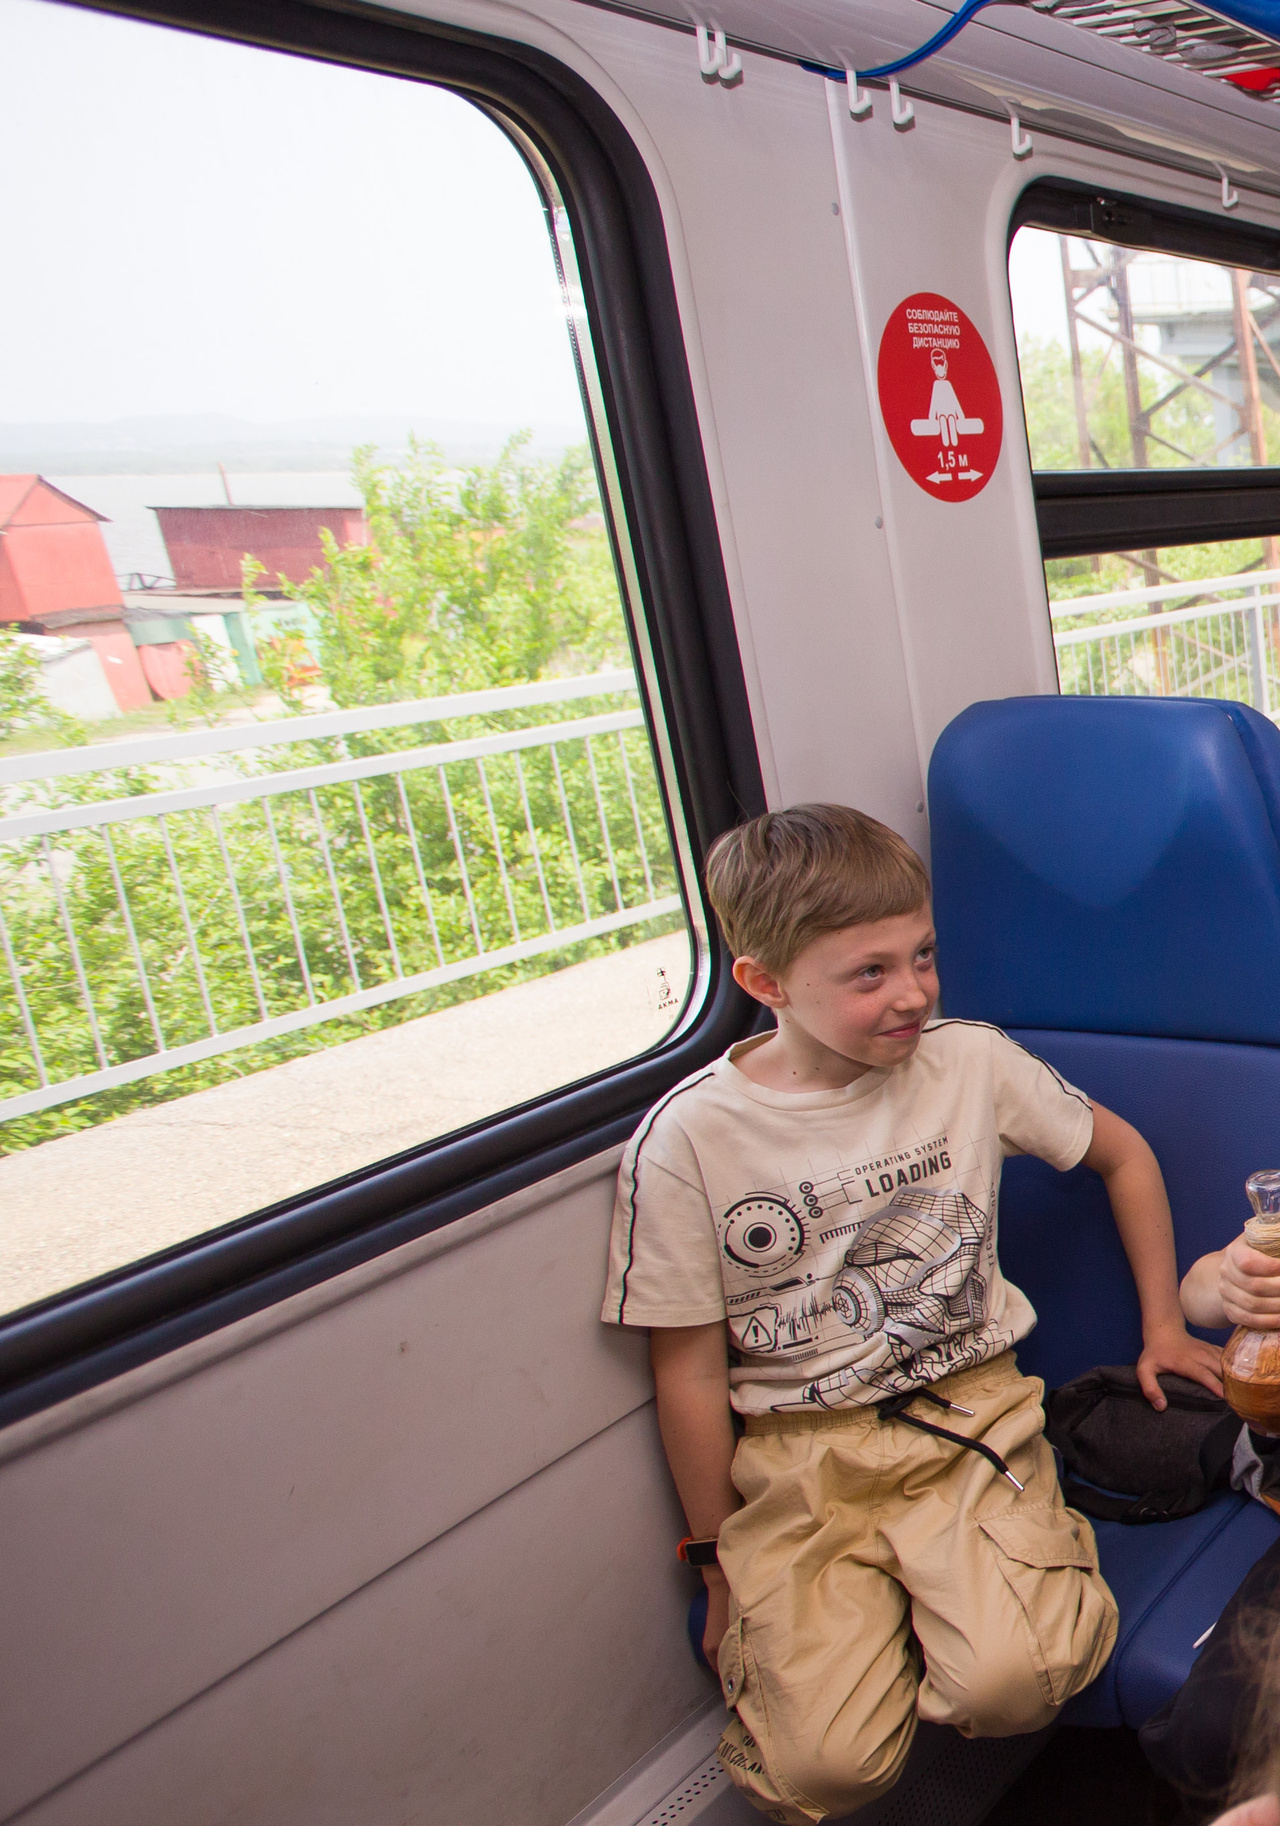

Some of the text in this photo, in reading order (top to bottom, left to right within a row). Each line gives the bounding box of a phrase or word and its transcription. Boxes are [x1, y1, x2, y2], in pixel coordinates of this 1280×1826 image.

[906, 308, 959, 323] СОБЛЮДАЙТЕ
[908, 322, 960, 336] БЕЗОПАСНУЮ
[913, 336, 960, 349] ДИСТАНЦИЮ
[937, 451, 956, 471] 1,5
[855, 1136, 949, 1175] OPERATING SYSTEM
[865, 1150, 952, 1198] LOADING
